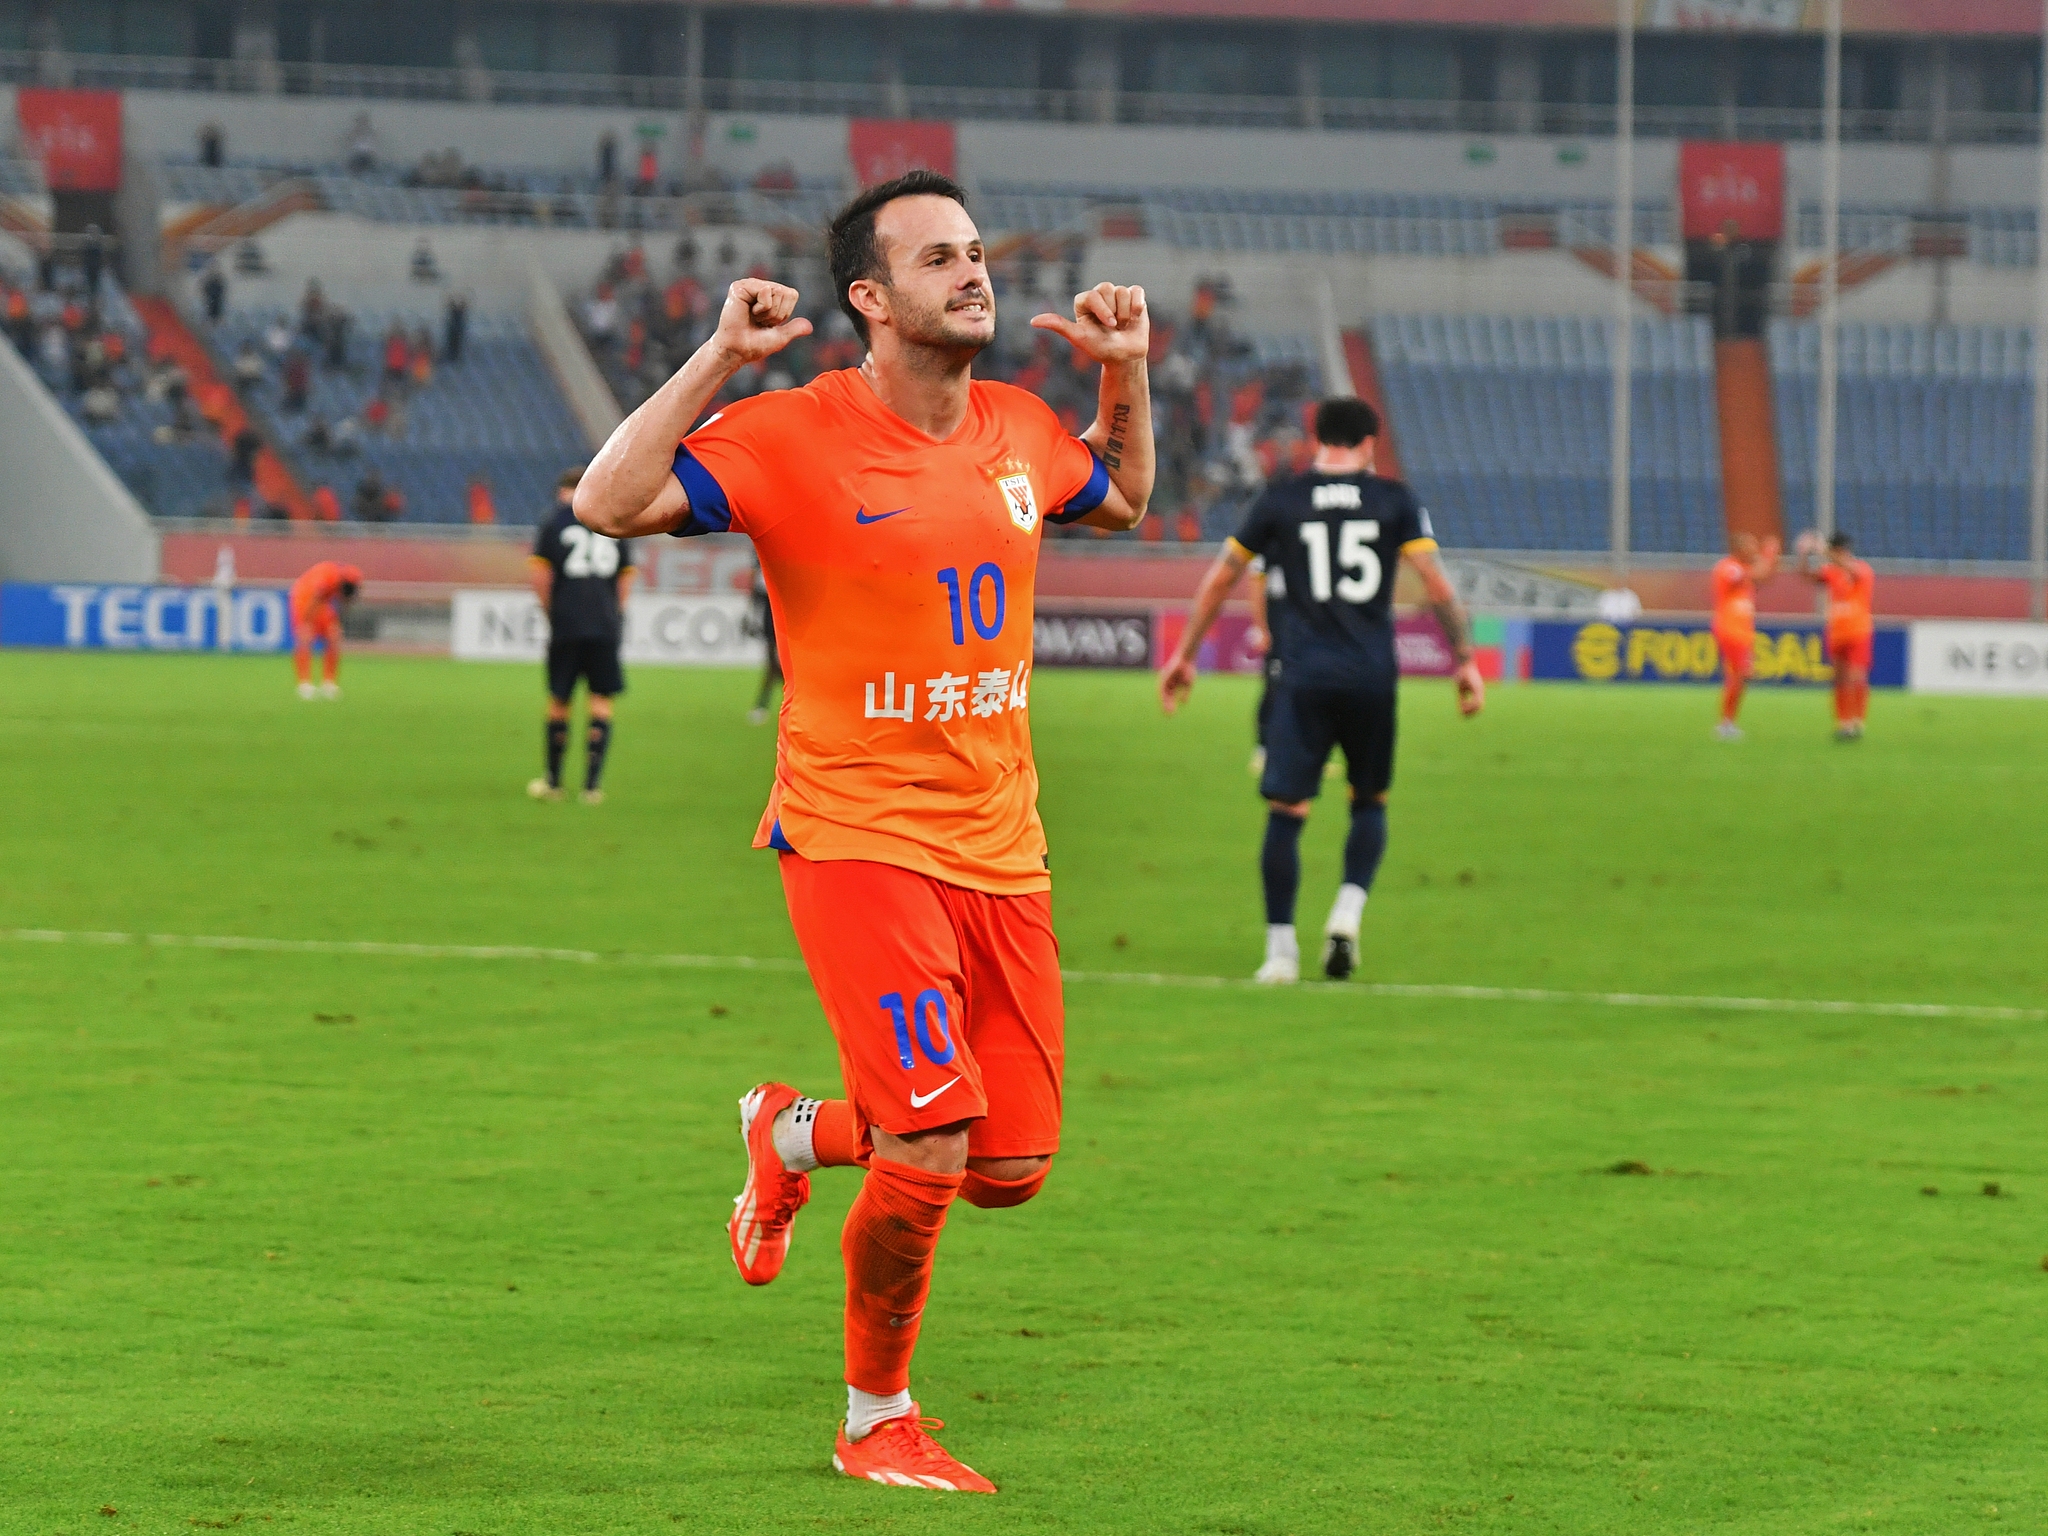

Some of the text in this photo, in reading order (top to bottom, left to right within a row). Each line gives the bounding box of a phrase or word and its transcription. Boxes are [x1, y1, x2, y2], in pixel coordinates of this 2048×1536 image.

[559, 523, 621, 580] 26
[1299, 519, 1382, 604] 15
[52, 585, 287, 650] TECNO
[937, 561, 1006, 646] 10
[864, 659, 1030, 723] 山东泰山
[878, 987, 956, 1070] 10
